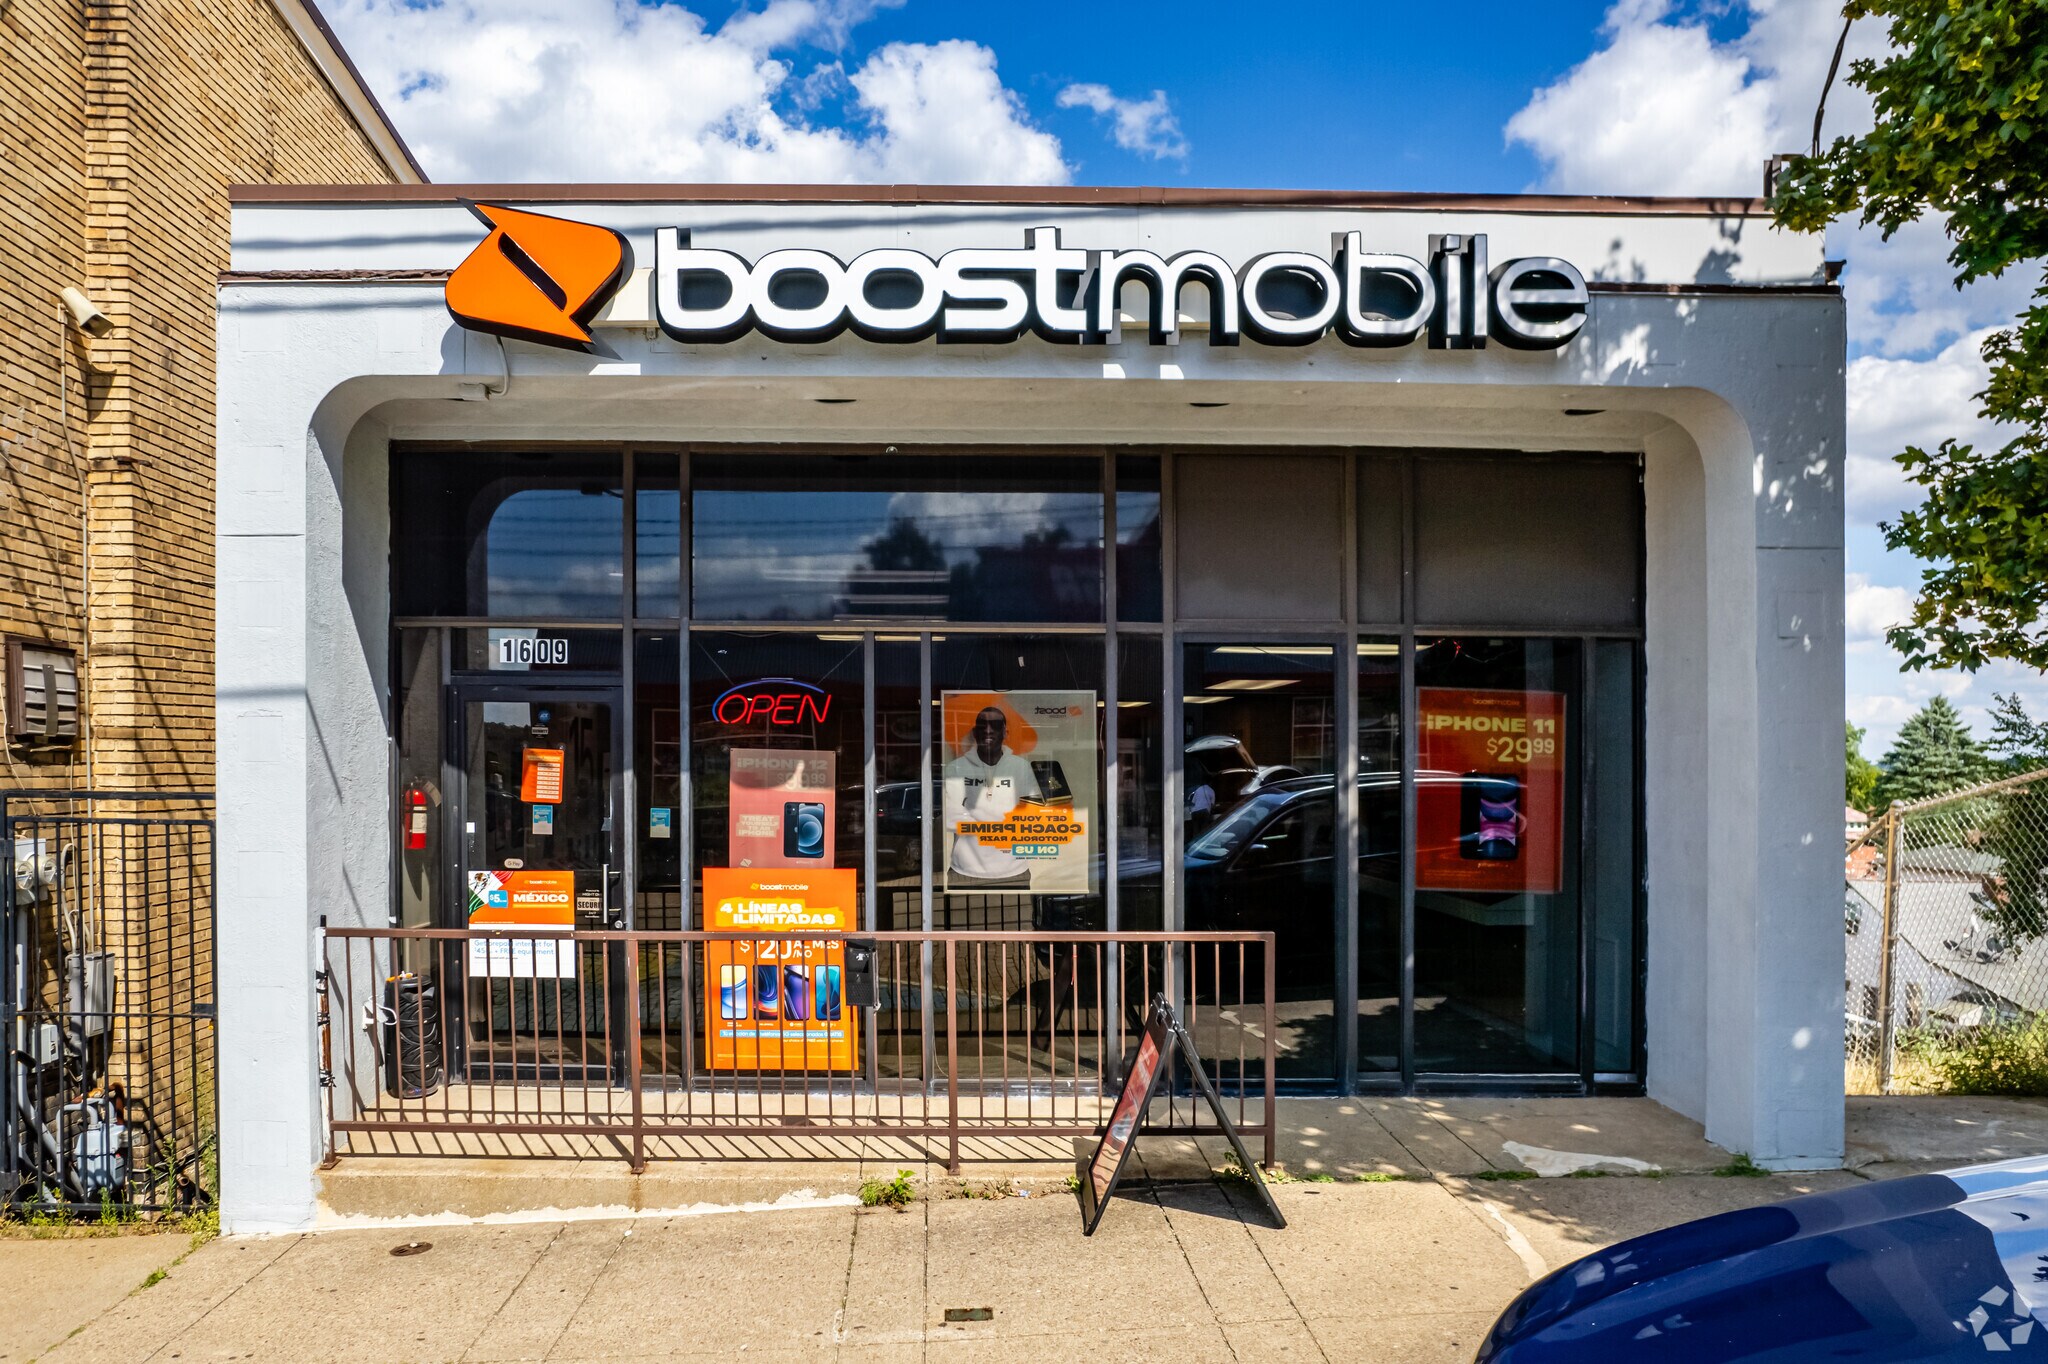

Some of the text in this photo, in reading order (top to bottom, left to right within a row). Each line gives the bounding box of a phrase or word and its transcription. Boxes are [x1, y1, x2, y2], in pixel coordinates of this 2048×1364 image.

[503, 639, 566, 663] 1609
[718, 694, 832, 724] OPEN
[1427, 714, 1555, 734] iPHONE 11
[809, 760, 828, 770] 12
[759, 883, 809, 891] boostmobile
[489, 893, 500, 903] $5
[513, 893, 569, 903] MÉXICO
[577, 901, 602, 909] SECURI
[720, 901, 802, 914] 4 LÍNEAS
[733, 914, 836, 925] ILIMITADAS
